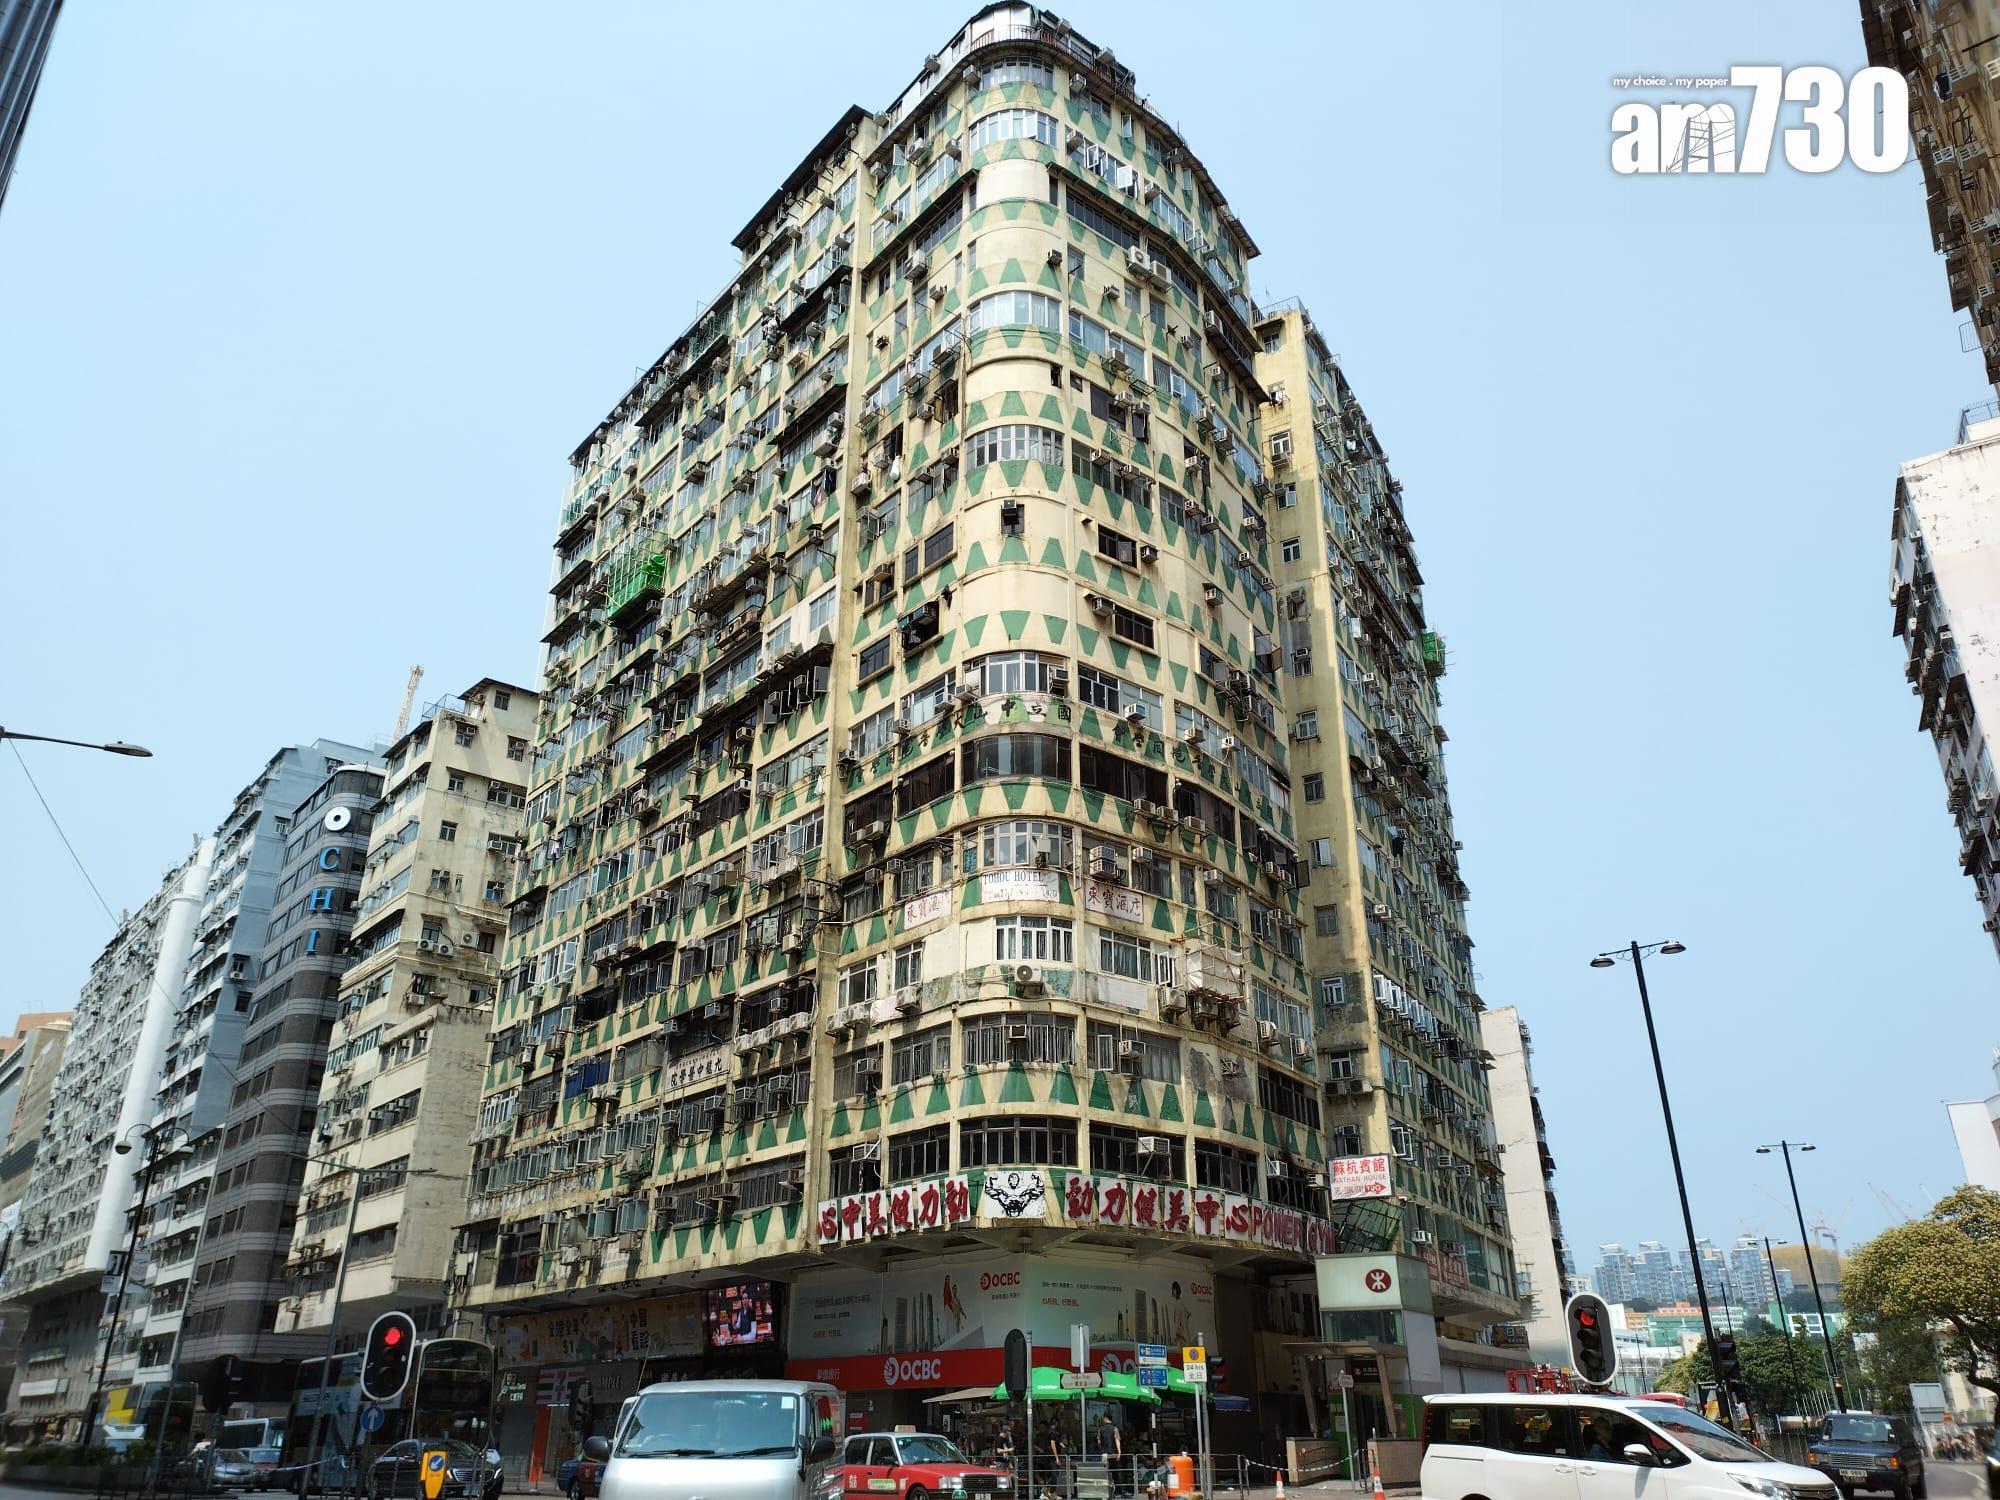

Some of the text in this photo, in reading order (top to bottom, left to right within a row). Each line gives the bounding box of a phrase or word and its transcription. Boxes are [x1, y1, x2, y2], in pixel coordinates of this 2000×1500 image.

[983, 870, 1044, 885] TOHOU HOTEL
[1333, 1158, 1385, 1175] 蘇杭賓館
[1363, 1173, 1387, 1182] HOUSE
[1253, 1205, 1302, 1247] POWER
[992, 1272, 1021, 1287] OCBC
[1197, 1285, 1213, 1295] OCBC
[901, 1359, 941, 1380] OCBC
